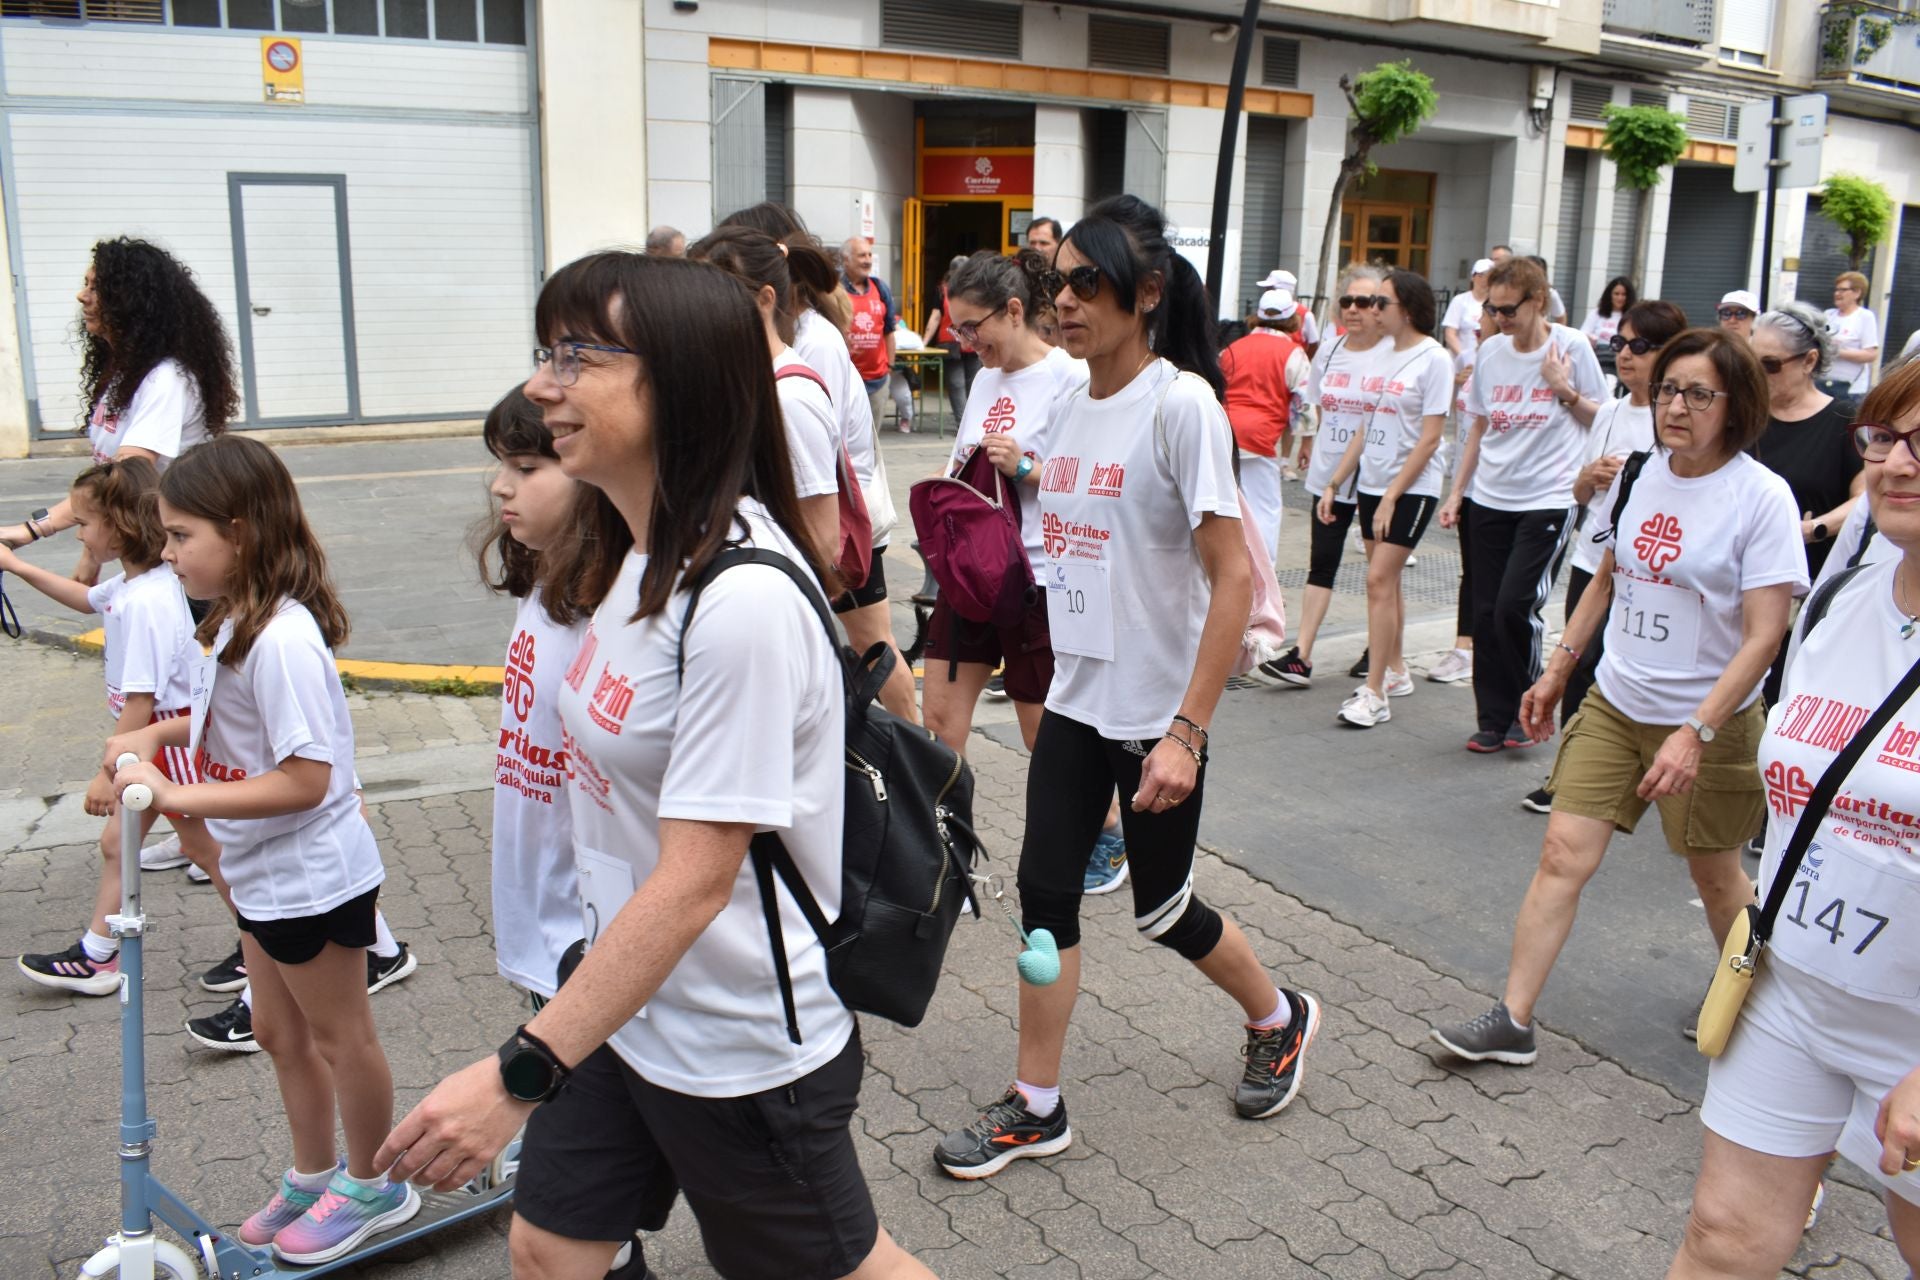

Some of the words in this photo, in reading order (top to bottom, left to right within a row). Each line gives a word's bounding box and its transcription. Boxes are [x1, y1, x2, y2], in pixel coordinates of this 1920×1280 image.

[1366, 428, 1386, 447] 02
[1090, 461, 1125, 489] berlin
[1064, 520, 1111, 541] Cáritas
[1066, 588, 1085, 614] 10
[1621, 605, 1671, 643] 115
[1780, 695, 1871, 753] SOLIDARI
[1882, 720, 1920, 758] ber
[498, 726, 568, 771] ritas
[1878, 754, 1920, 772] PACKAG
[496, 753, 562, 788] parroquial
[1829, 810, 1920, 841] Interparroial
[1831, 790, 1920, 831] árita
[1832, 825, 1850, 837] de
[1853, 829, 1913, 854] Calahora
[1786, 880, 1890, 955] 147
